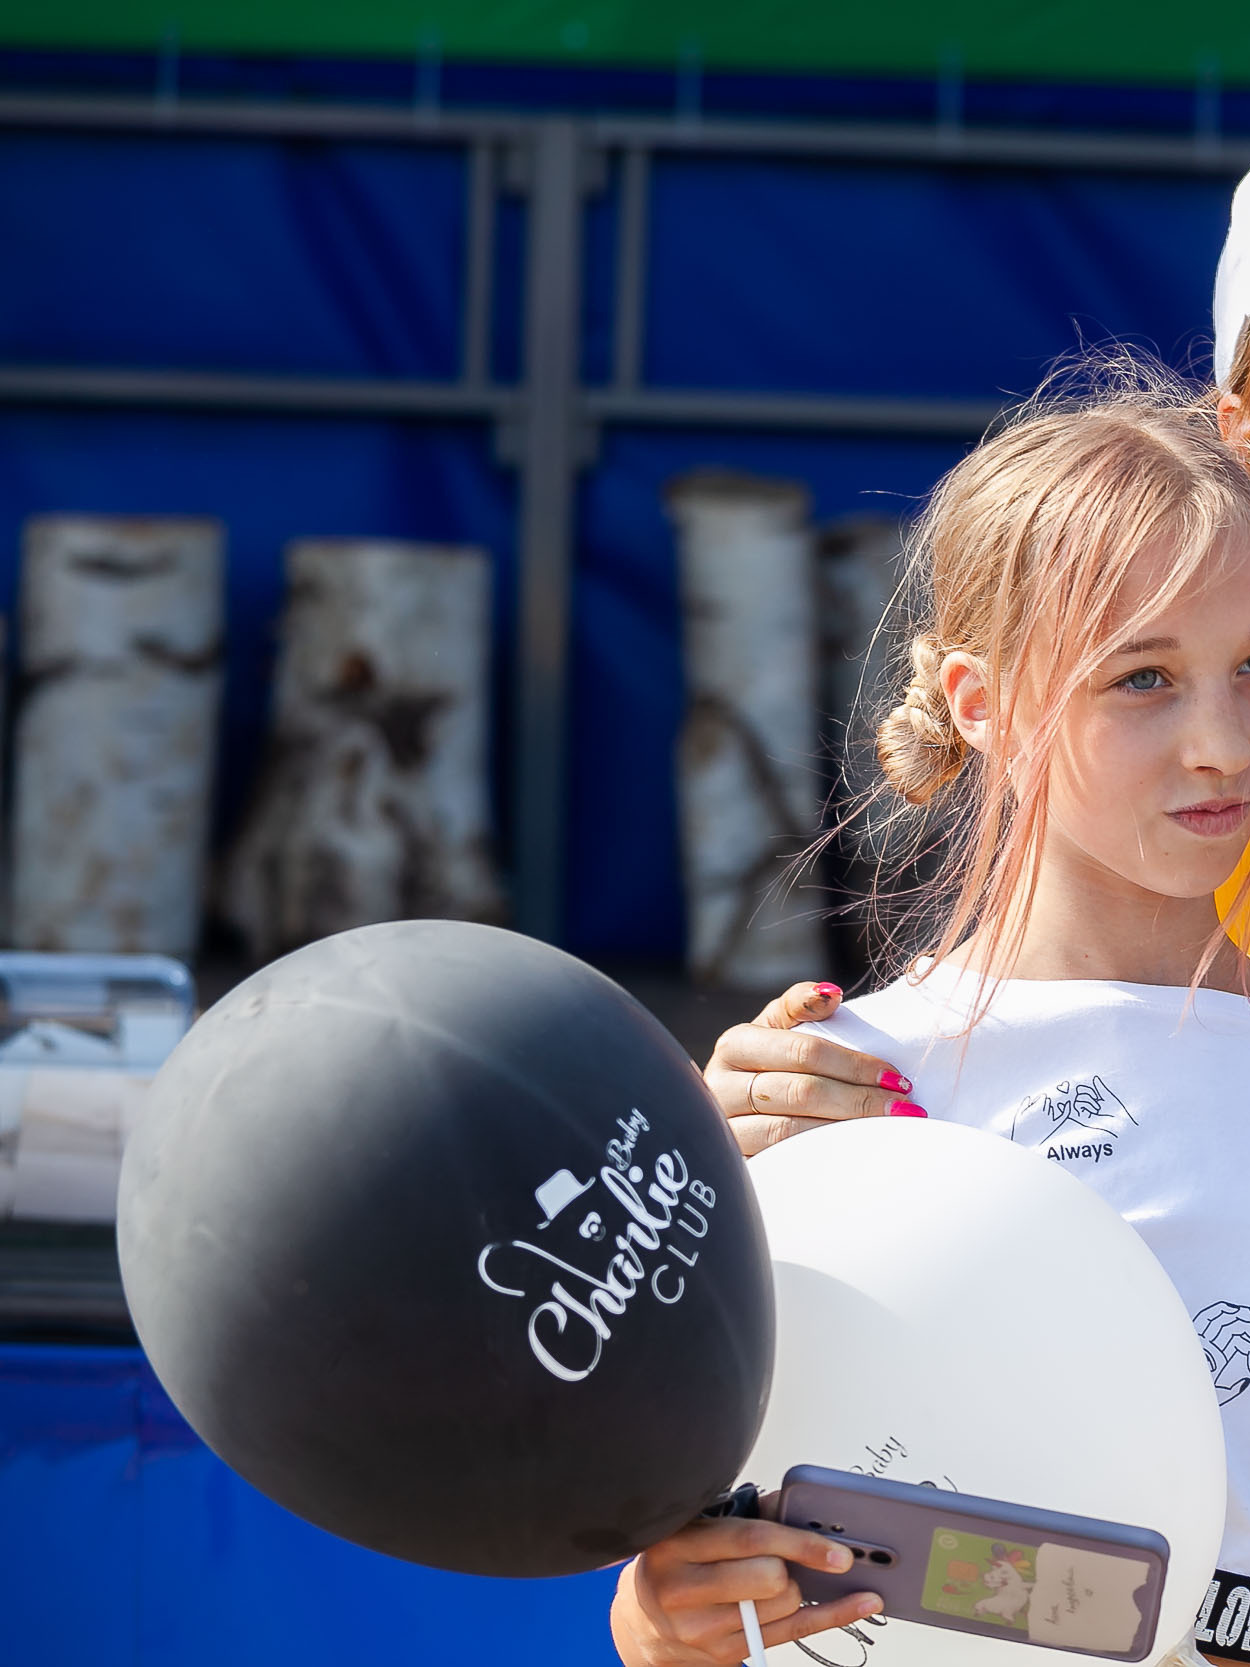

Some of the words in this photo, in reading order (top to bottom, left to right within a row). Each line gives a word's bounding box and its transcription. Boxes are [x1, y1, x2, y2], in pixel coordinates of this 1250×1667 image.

[605, 1107, 650, 1171] Baby
[1047, 1143, 1113, 1163] Always
[527, 1149, 689, 1382] Charlie
[651, 1179, 716, 1304] CLUB
